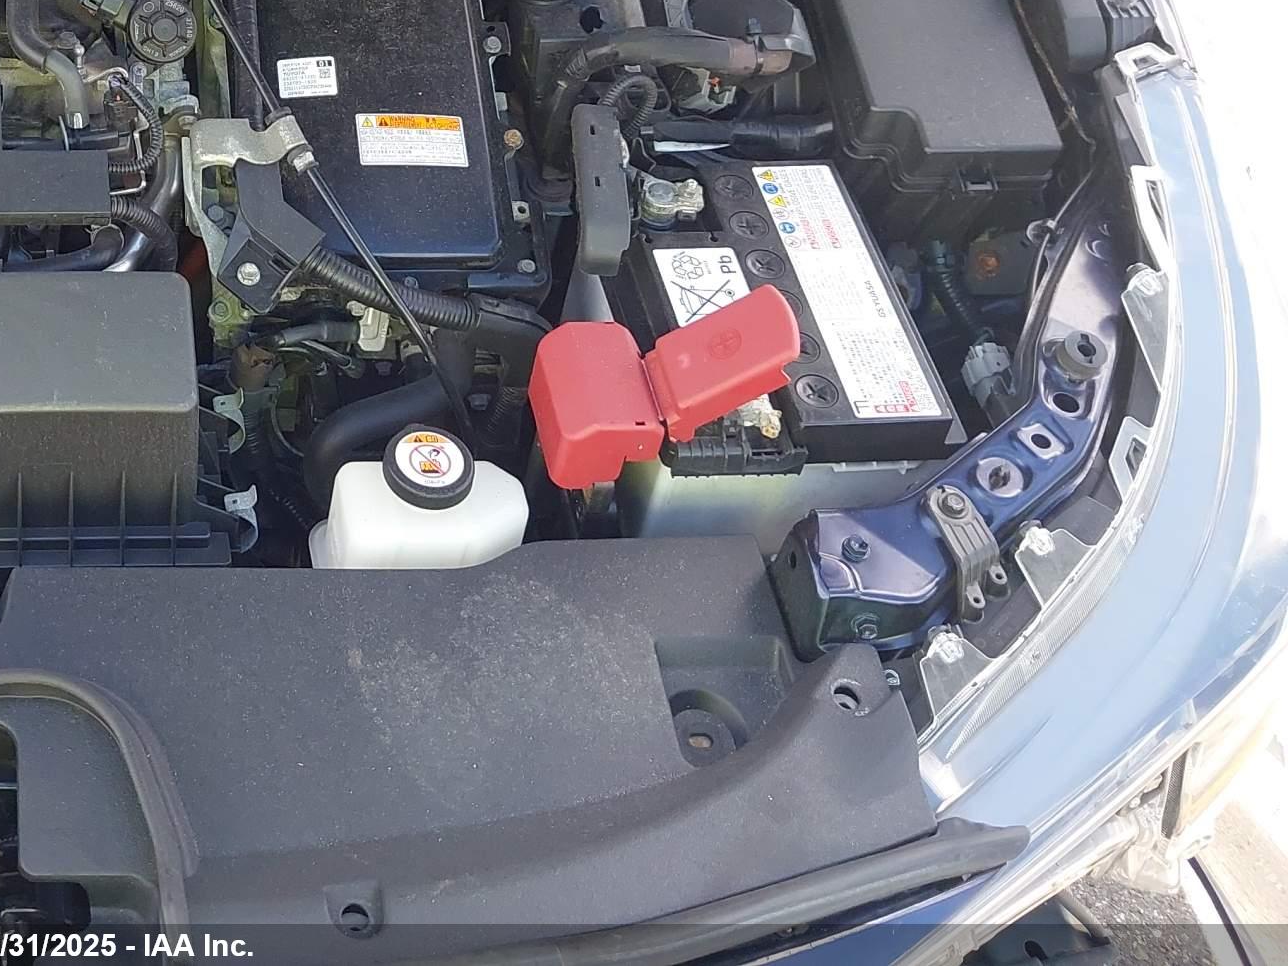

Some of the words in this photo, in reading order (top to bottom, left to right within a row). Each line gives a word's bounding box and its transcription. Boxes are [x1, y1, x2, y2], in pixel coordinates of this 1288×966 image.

[185, 17, 194, 38] 37140
[717, 255, 737, 274] Pb
[862, 280, 881, 306] YUASA
